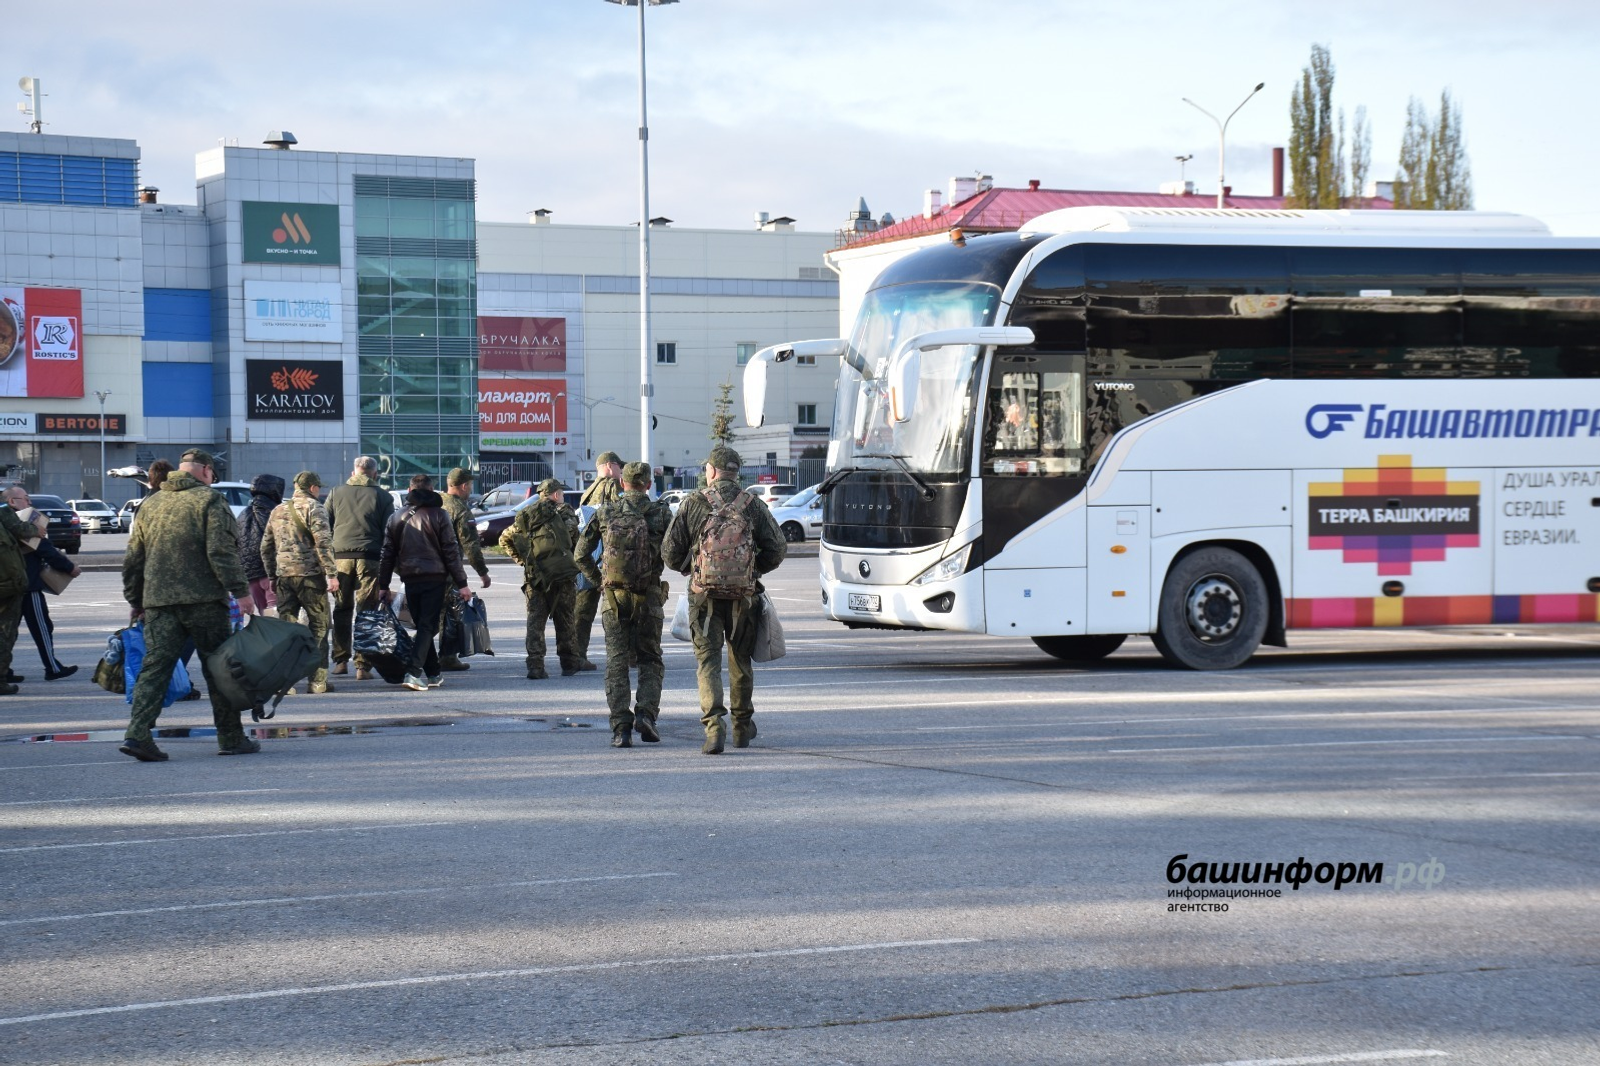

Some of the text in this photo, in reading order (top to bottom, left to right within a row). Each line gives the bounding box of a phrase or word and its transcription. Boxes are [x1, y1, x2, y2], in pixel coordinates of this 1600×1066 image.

[295, 297, 330, 309] ЧИТАЙ
[294, 308, 331, 320] ГОРОД
[1094, 382, 1136, 391] YUTONG
[255, 394, 335, 408] KARATOV
[45, 417, 119, 429] BERTONE
[495, 412, 517, 425] ДЛЯ
[519, 412, 551, 425] ДОМА
[482, 437, 567, 446] ФРЕШМАРКЕТ #3
[1503, 472, 1556, 491] ДУША
[1318, 507, 1470, 524] ТЕРРА БАШКИРИЯ
[1503, 500, 1566, 519] СЕРДЦЕ
[1503, 529, 1581, 546] ЕВРАЗИИ.
